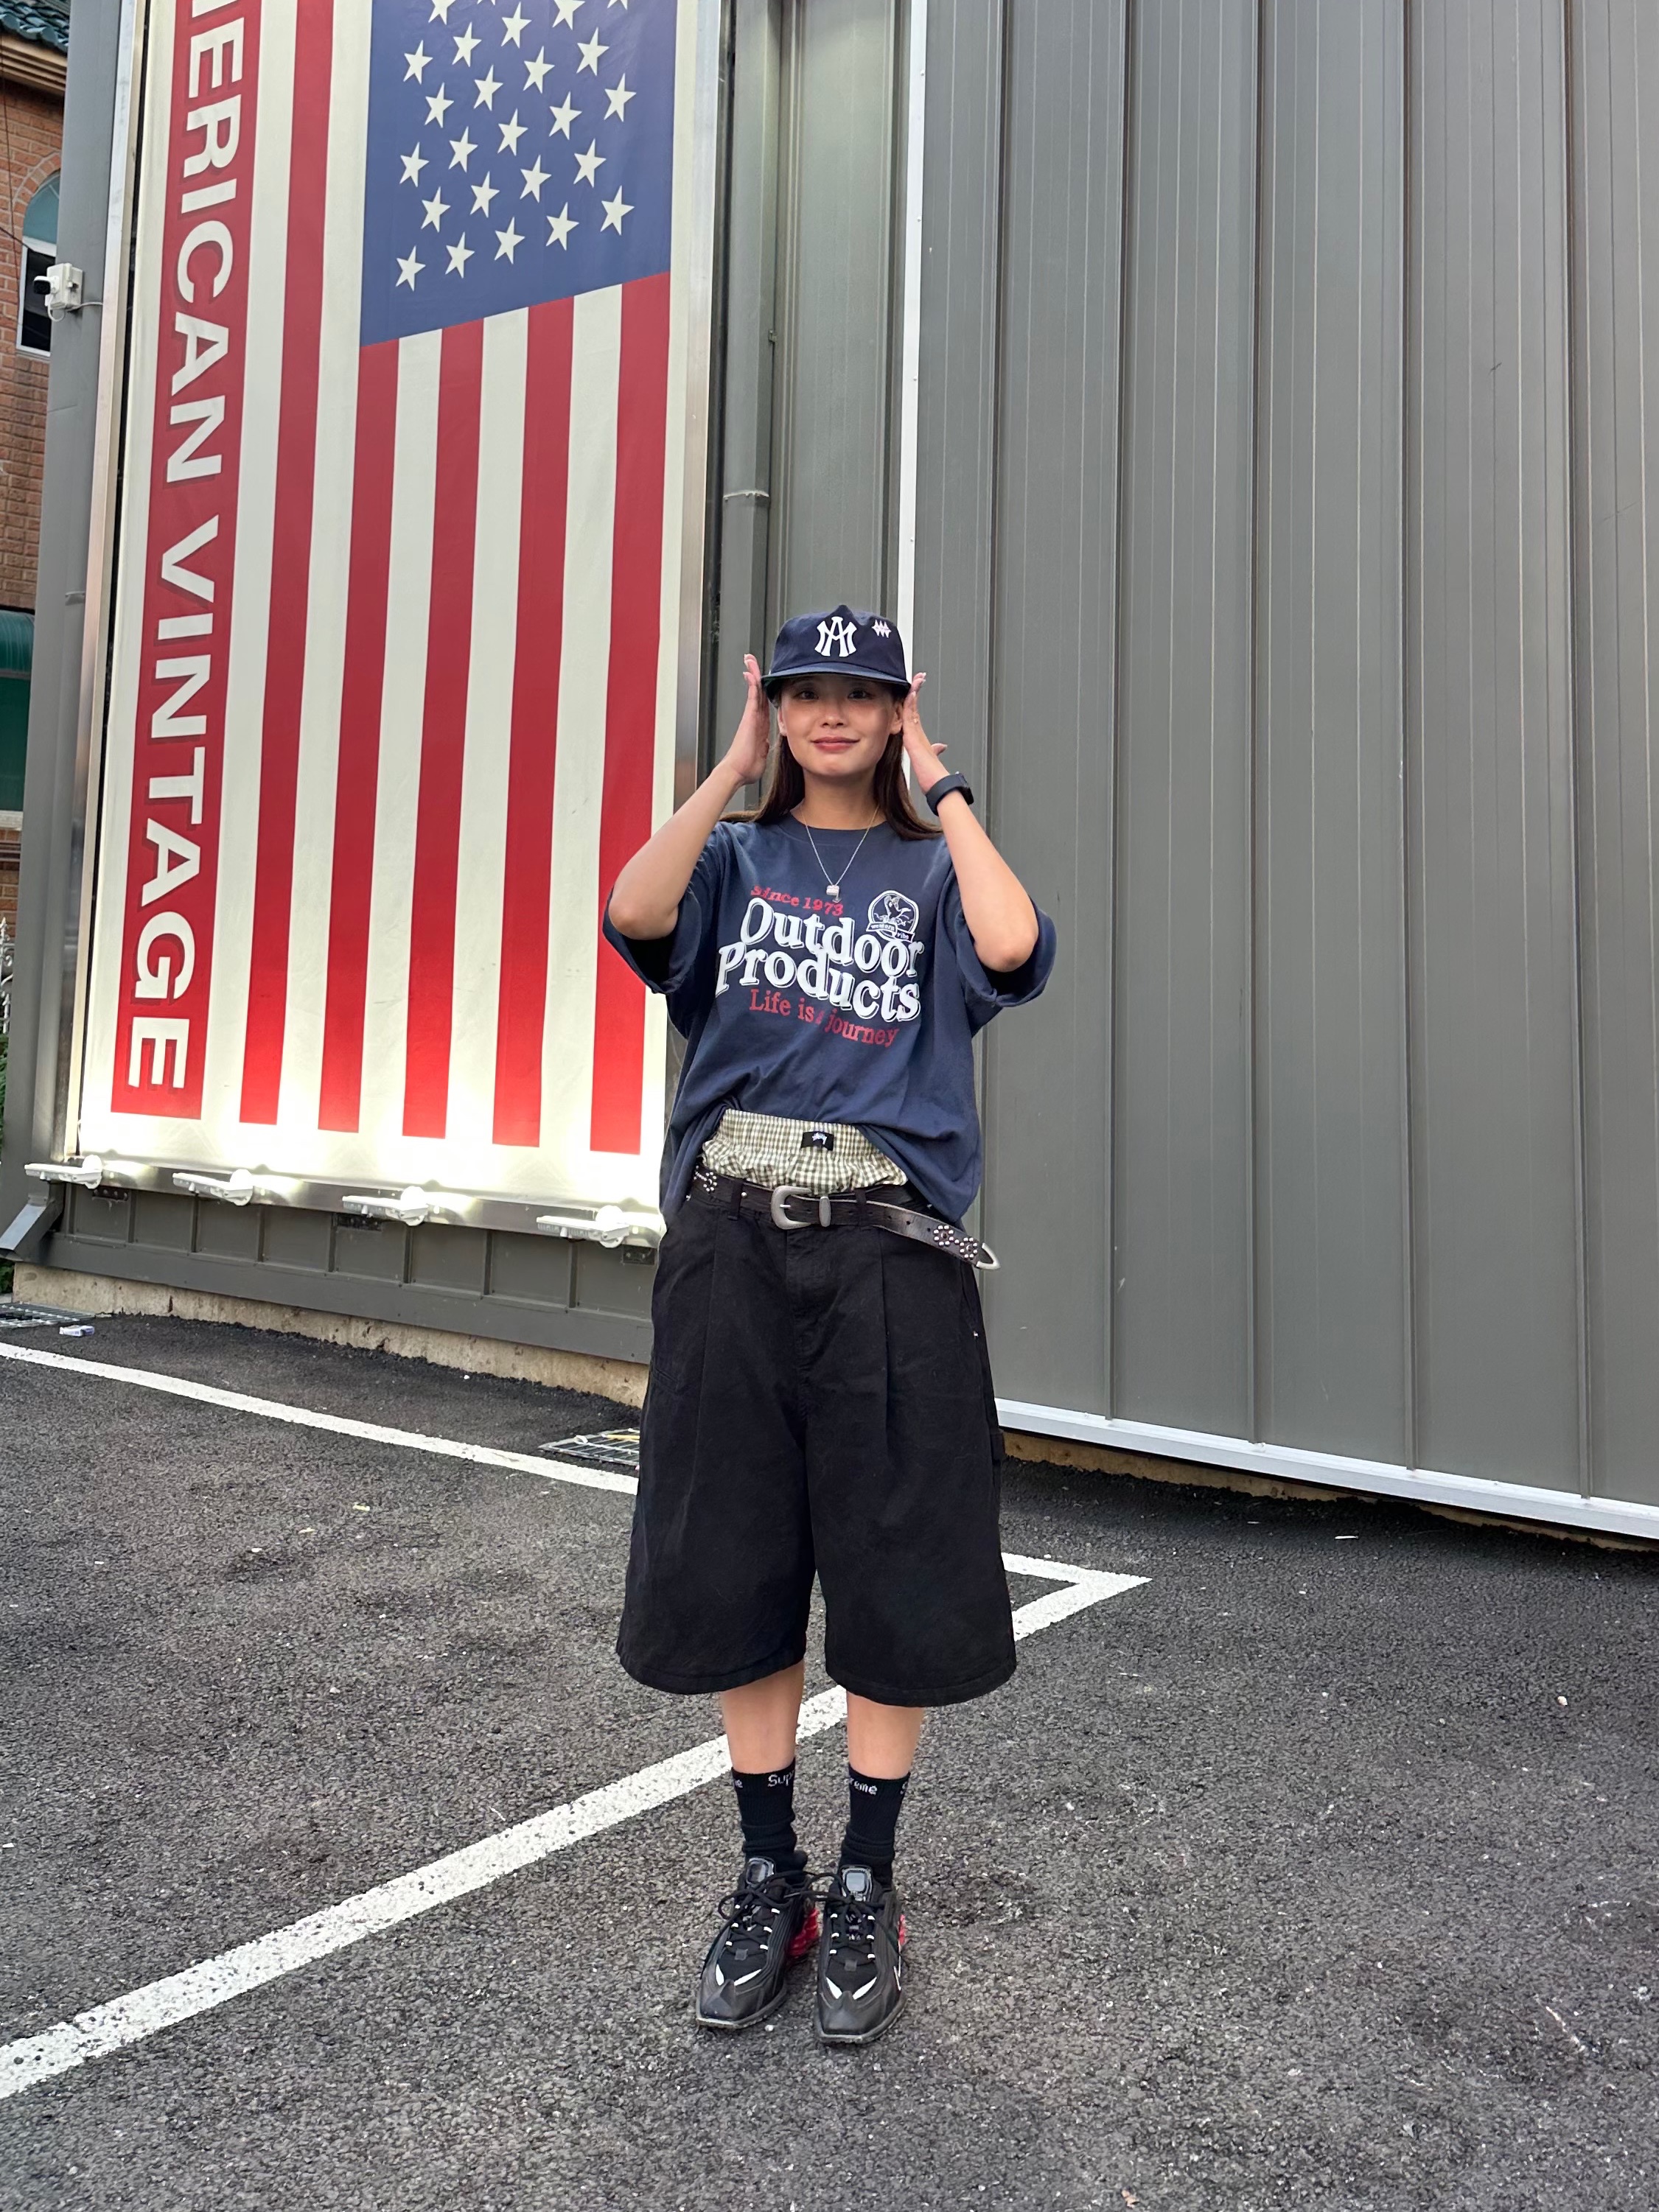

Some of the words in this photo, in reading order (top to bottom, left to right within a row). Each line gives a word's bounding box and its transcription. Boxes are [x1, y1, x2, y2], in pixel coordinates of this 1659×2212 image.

[167, 0, 245, 483] ERICAN
[128, 514, 219, 1089] VINTAGE
[740, 897, 924, 978] Outdoor
[750, 885, 800, 907] Since
[803, 897, 844, 916] 1973
[715, 941, 921, 1023] Products
[749, 989, 792, 1016] Life
[797, 998, 814, 1023] is
[825, 1008, 900, 1048] journey
